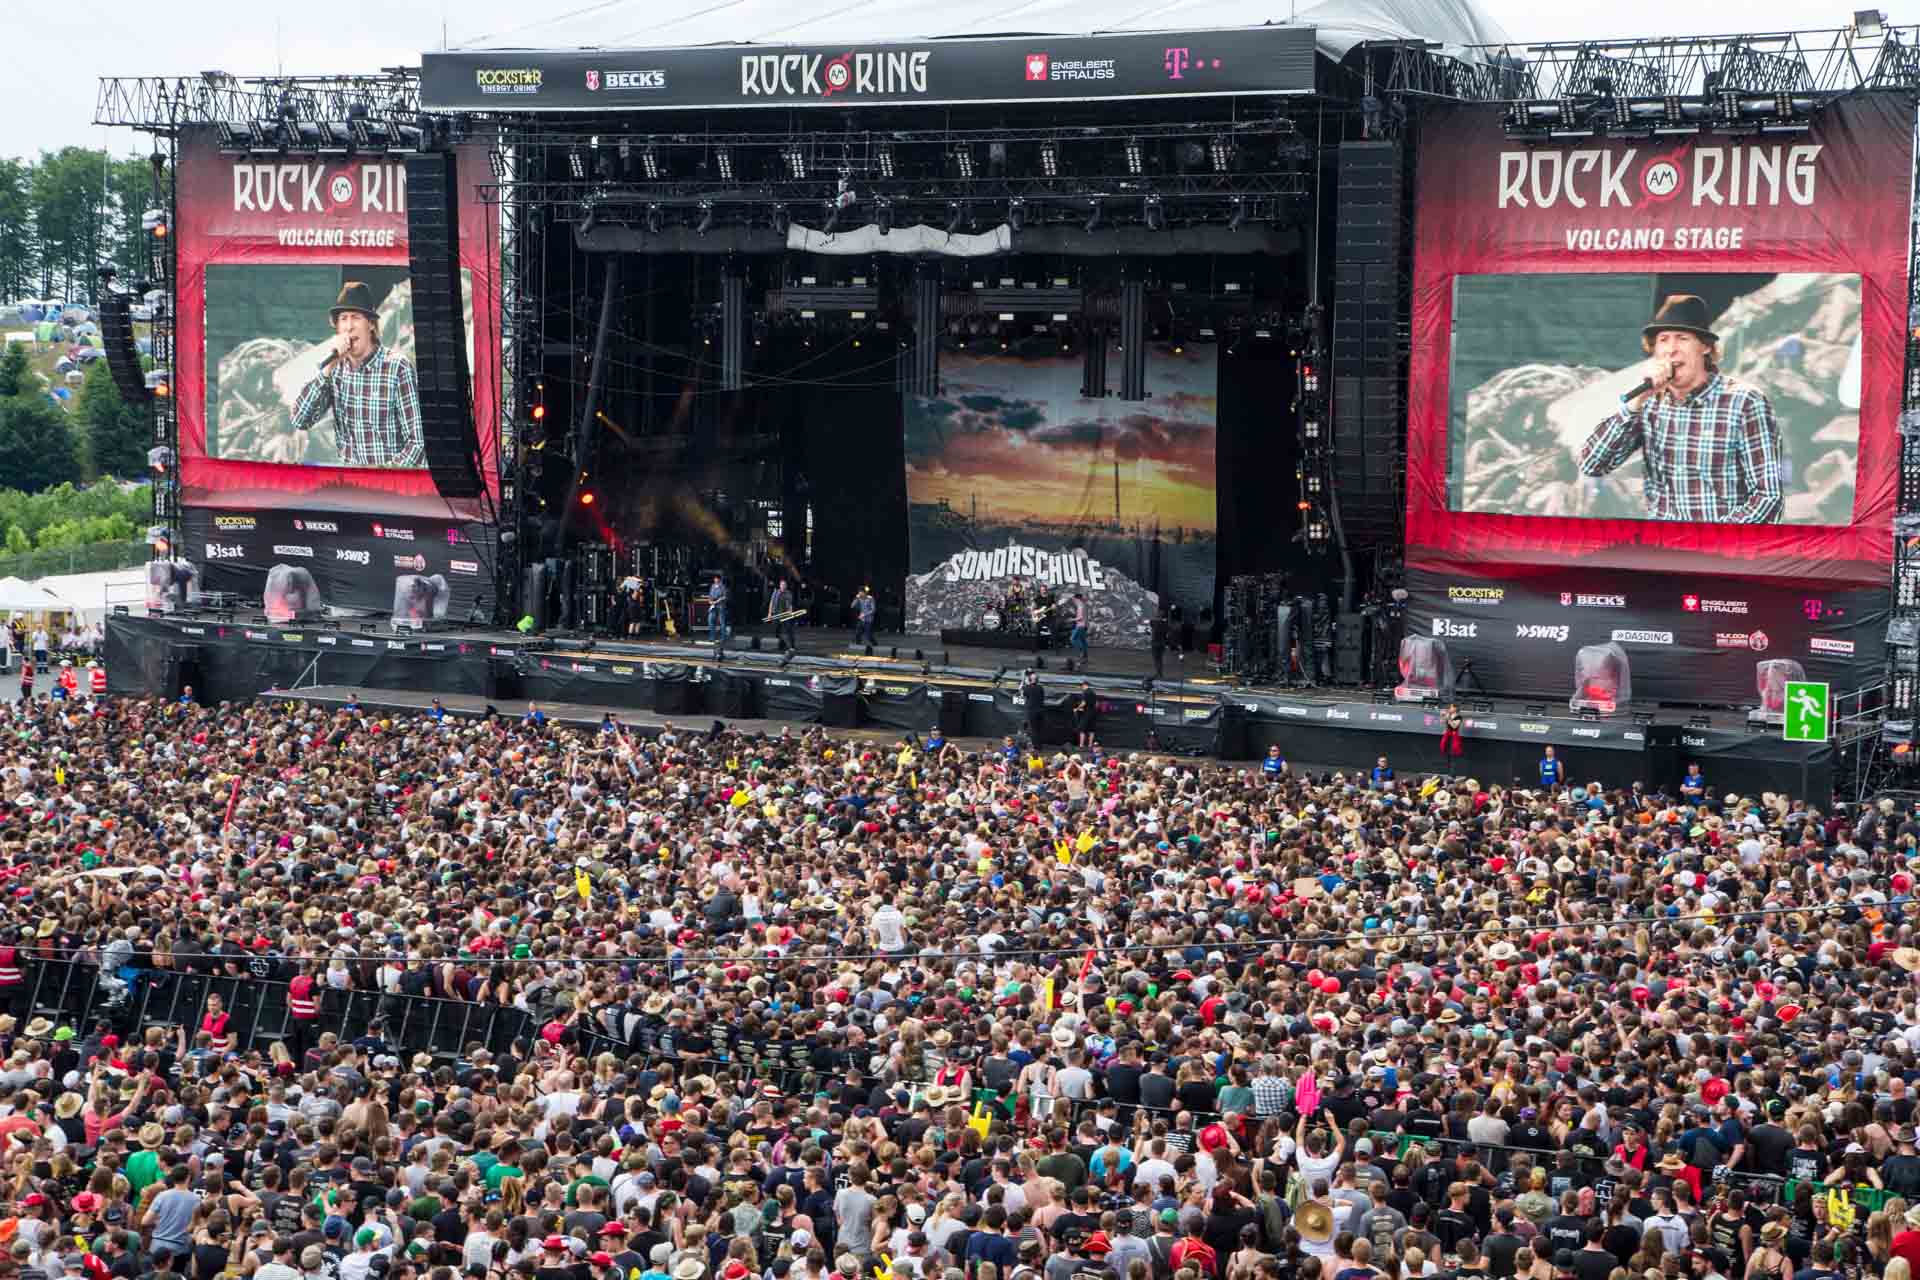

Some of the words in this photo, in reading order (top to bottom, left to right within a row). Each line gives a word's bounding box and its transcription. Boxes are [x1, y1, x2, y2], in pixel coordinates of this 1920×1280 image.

[741, 54, 822, 95] ROCK
[856, 51, 930, 93] RING
[1051, 60, 1115, 70] ENGELBERT
[477, 69, 542, 85] ROCKSTAR
[606, 71, 665, 88] BECK'S
[1051, 70, 1115, 81] STRAUSS
[482, 85, 511, 93] ENERGY
[514, 85, 537, 93] DRINK
[1498, 148, 1638, 208] ROCK
[1649, 170, 1675, 186] AM
[1692, 145, 1824, 207] RING
[233, 163, 325, 213] ROCK
[362, 164, 408, 213] RI
[278, 228, 344, 247] VOLCANO
[350, 228, 395, 248] STAGE
[1565, 227, 1665, 250] VOLCANO
[1674, 227, 1744, 250] STAGE
[945, 544, 1106, 591] SONDASCHULE
[1576, 594, 1626, 607] BECK'S
[1701, 606, 1748, 614] STRAUSS
[1432, 618, 1477, 637] 3sat
[1528, 624, 1569, 642] SWR3
[1625, 632, 1669, 642] DASDING
